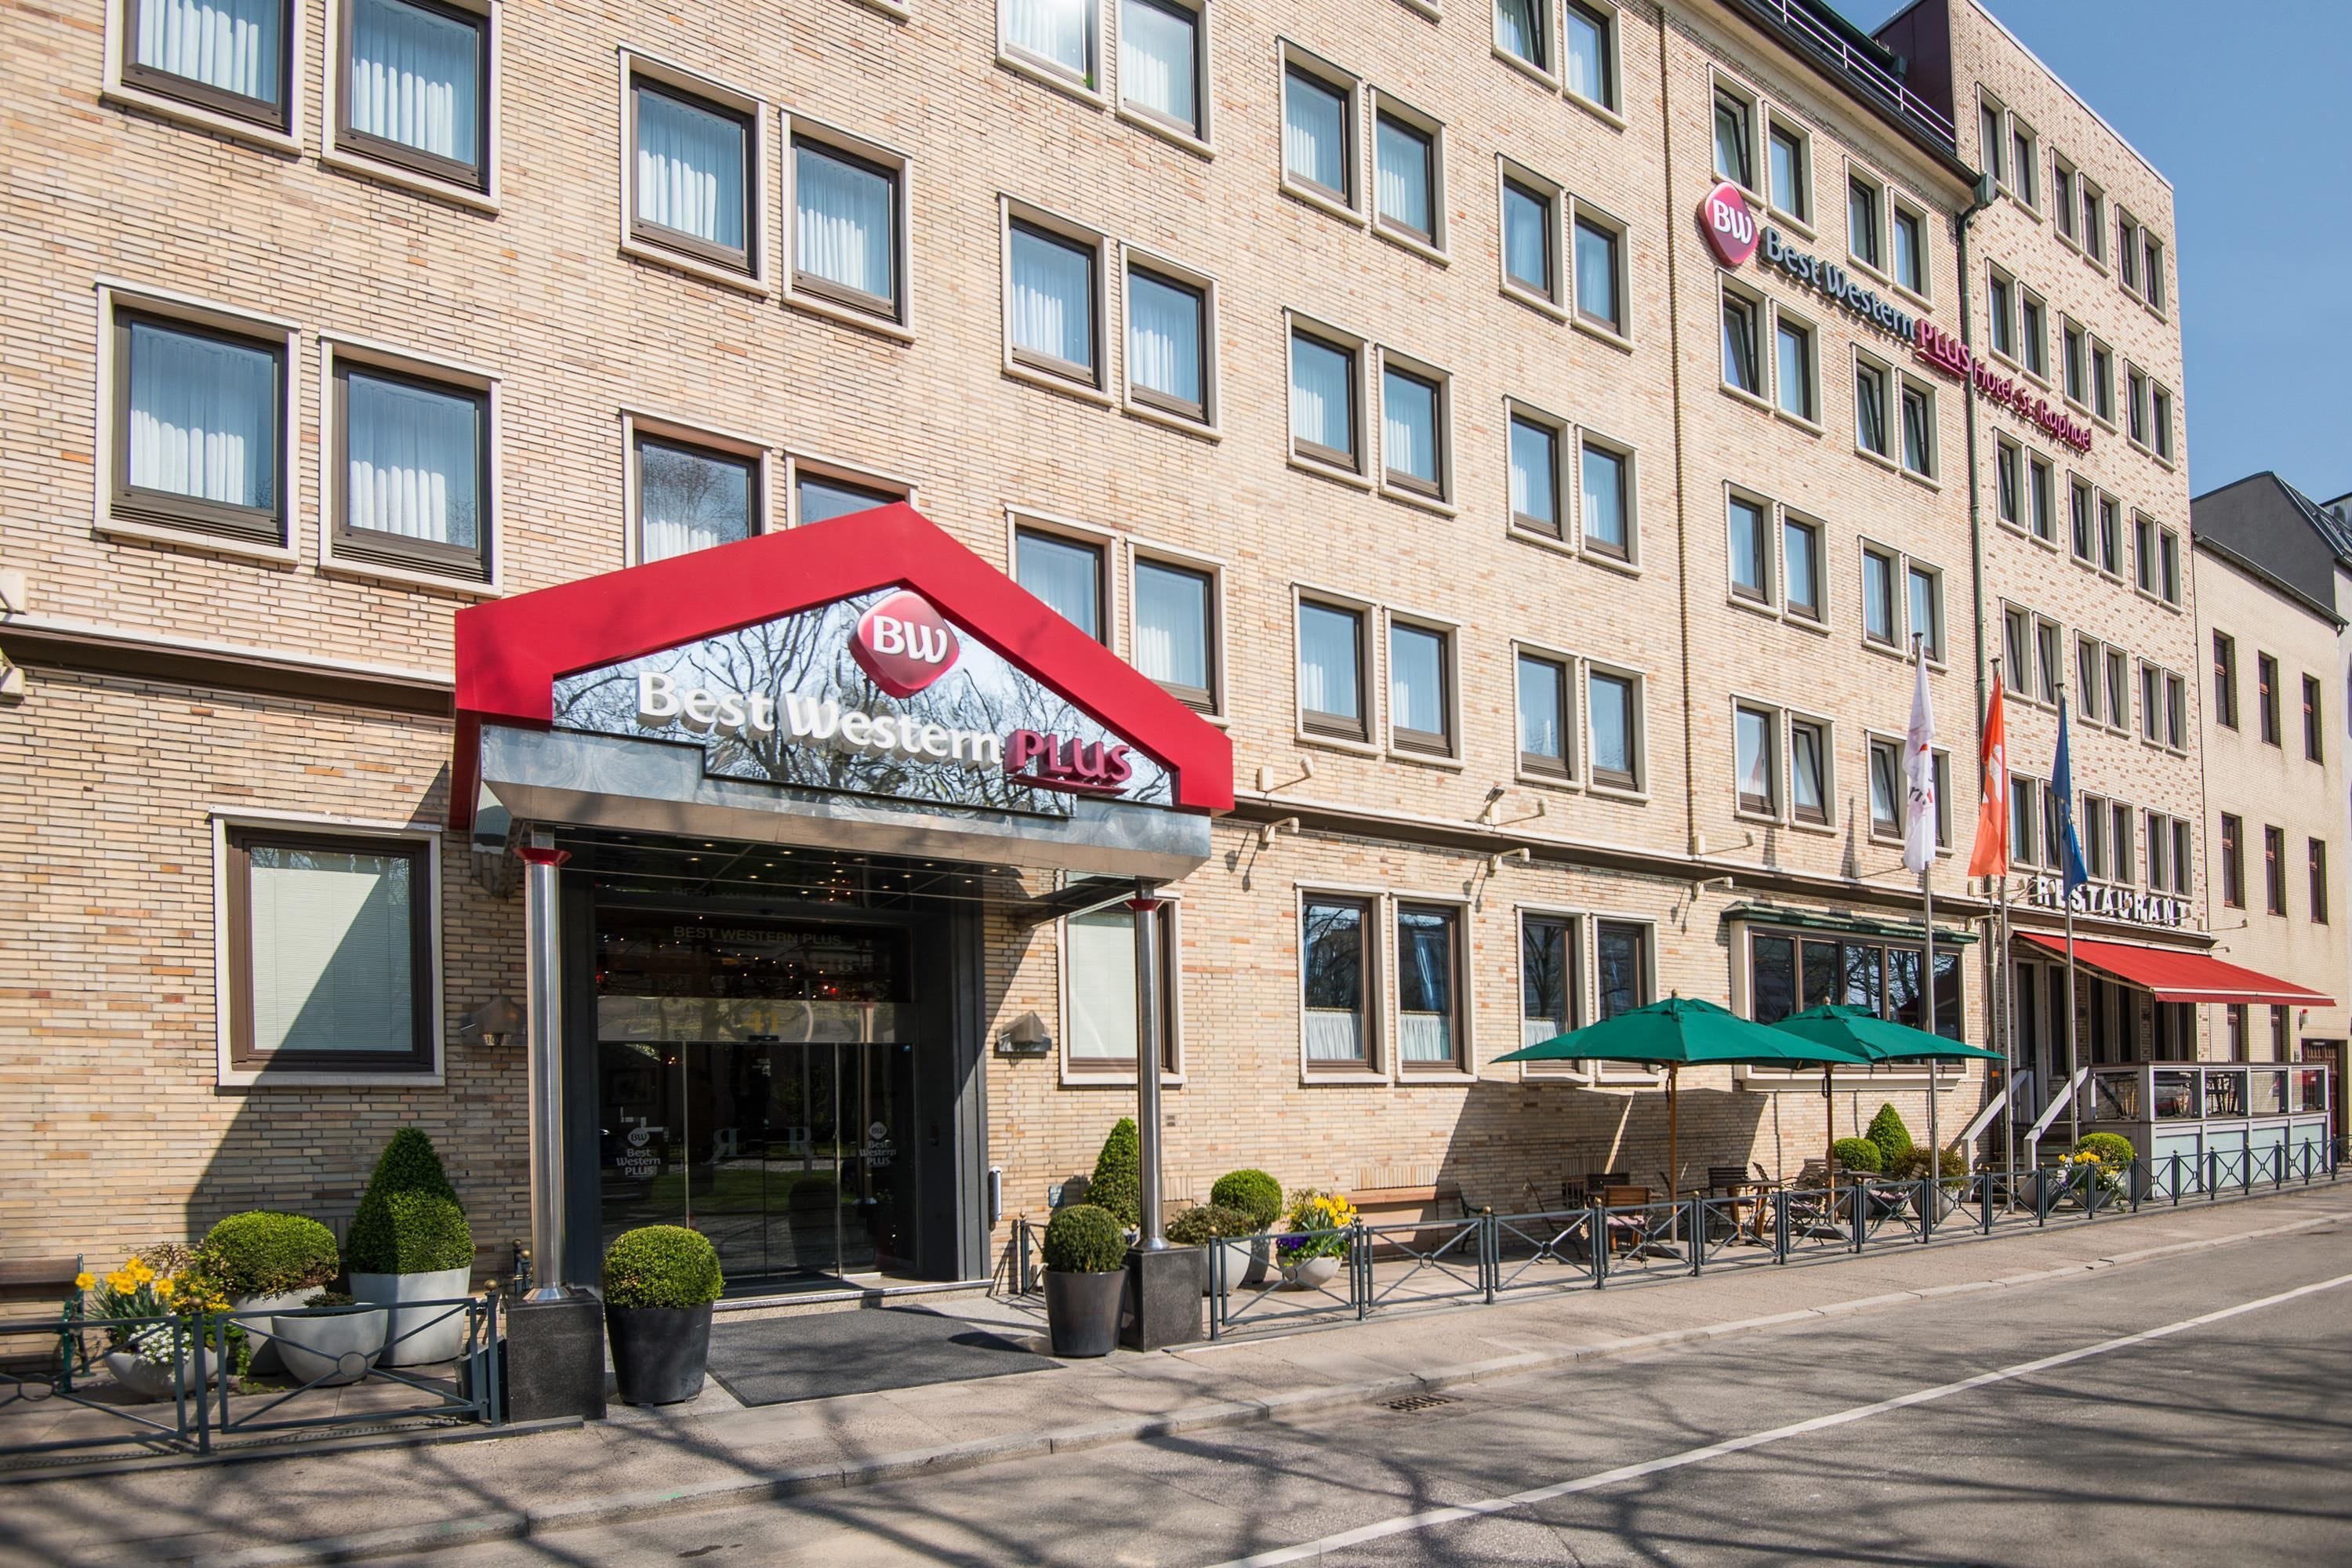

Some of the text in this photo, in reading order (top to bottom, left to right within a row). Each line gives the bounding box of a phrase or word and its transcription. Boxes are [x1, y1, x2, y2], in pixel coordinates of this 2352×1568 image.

[1712, 198, 1752, 245] BW
[1763, 226, 1821, 286] Best
[1822, 260, 1915, 340] Western
[1918, 318, 1972, 372] PLUS
[1973, 358, 2014, 402] Hotel
[873, 615, 949, 663] BW
[637, 670, 1132, 785] Best Western PLUS
[673, 926, 842, 946] BEST WESTERN PLUS
[630, 1133, 647, 1142] BW
[626, 1148, 652, 1157] Best
[615, 1156, 661, 1167] Western
[866, 1156, 891, 1166] PLUS
[625, 1167, 653, 1176] PLUS
